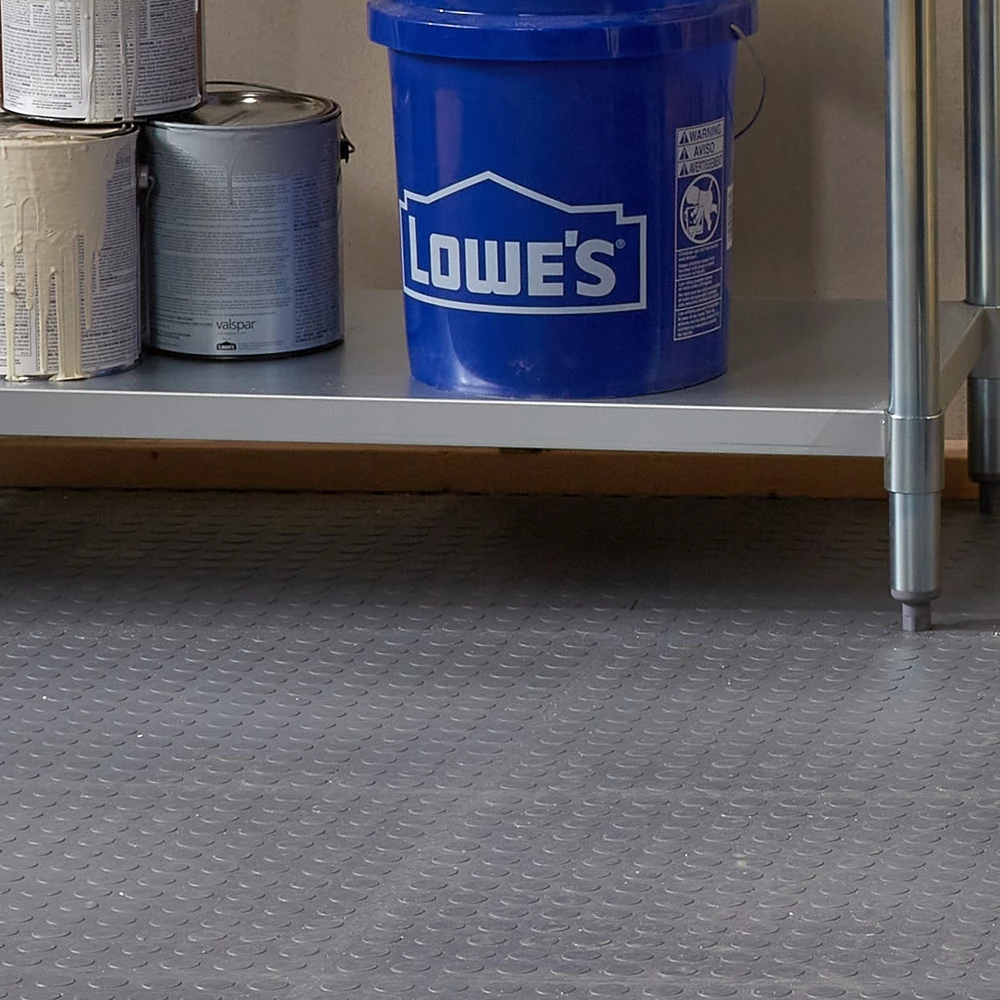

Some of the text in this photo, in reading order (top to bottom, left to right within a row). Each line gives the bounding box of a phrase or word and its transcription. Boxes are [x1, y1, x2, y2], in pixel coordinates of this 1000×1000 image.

[689, 123, 721, 142] WARNING
[693, 141, 715, 158] AVISO
[408, 215, 616, 298] LOWE'S
[216, 318, 256, 332] valspar
